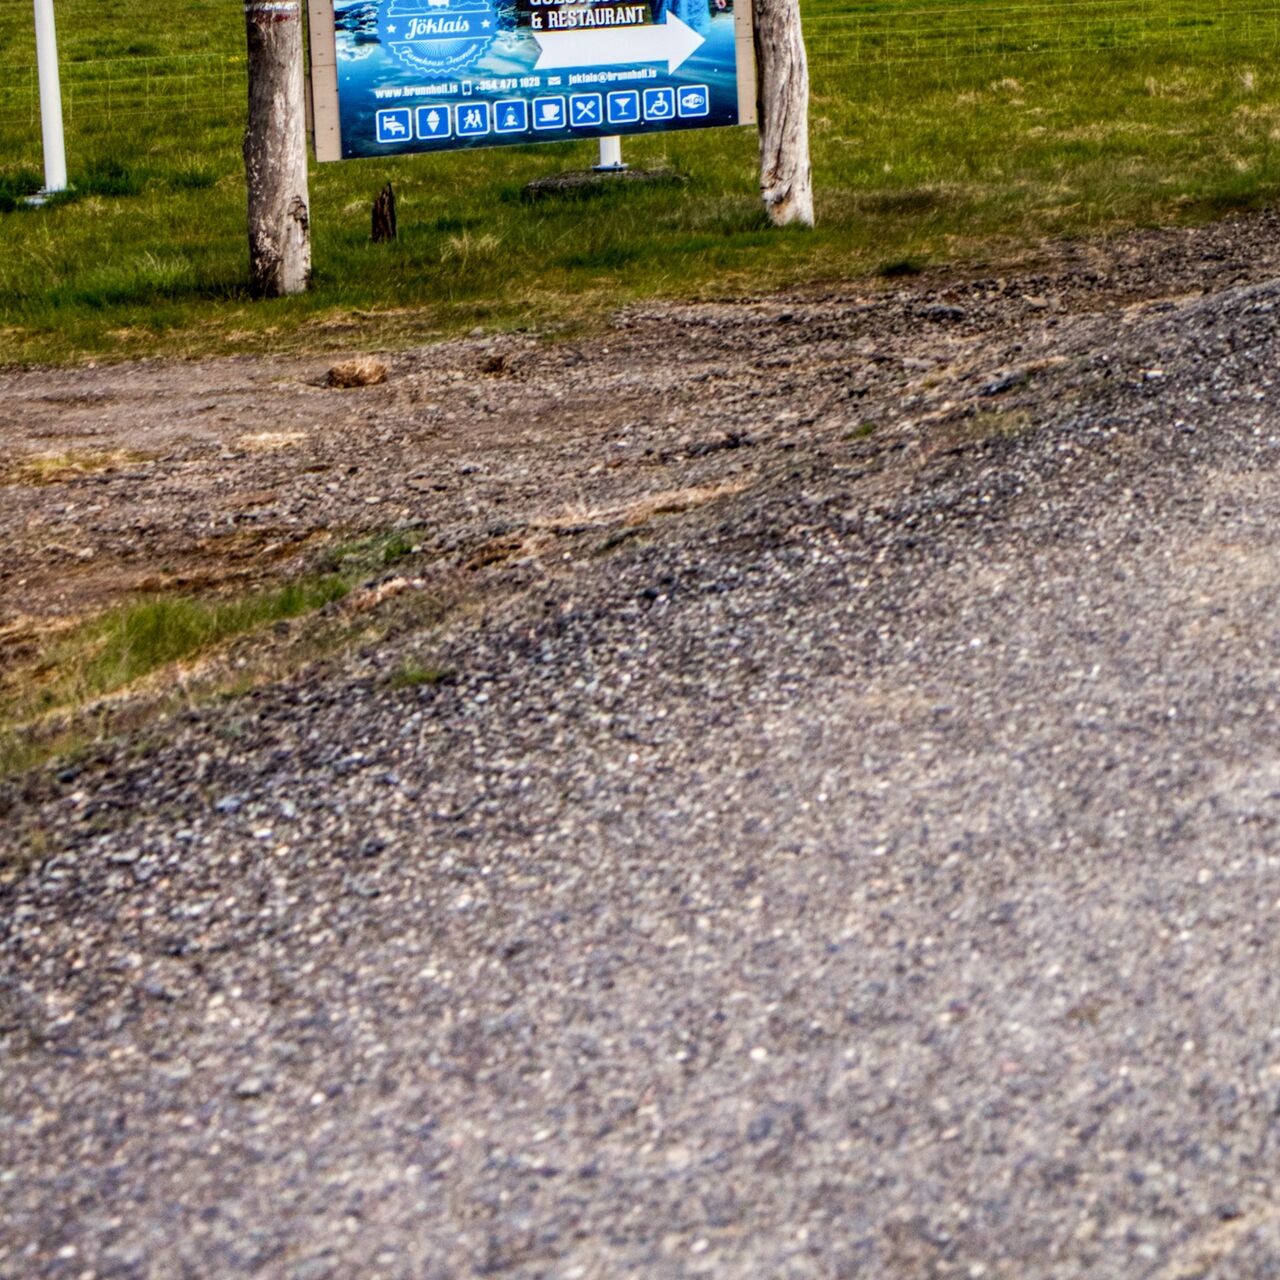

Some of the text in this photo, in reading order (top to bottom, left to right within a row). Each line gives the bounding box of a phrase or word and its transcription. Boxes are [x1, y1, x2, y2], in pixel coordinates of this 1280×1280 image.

[531, 5, 646, 29] & RESTAURANT
[375, 83, 459, 99] www.brunnholl.is
